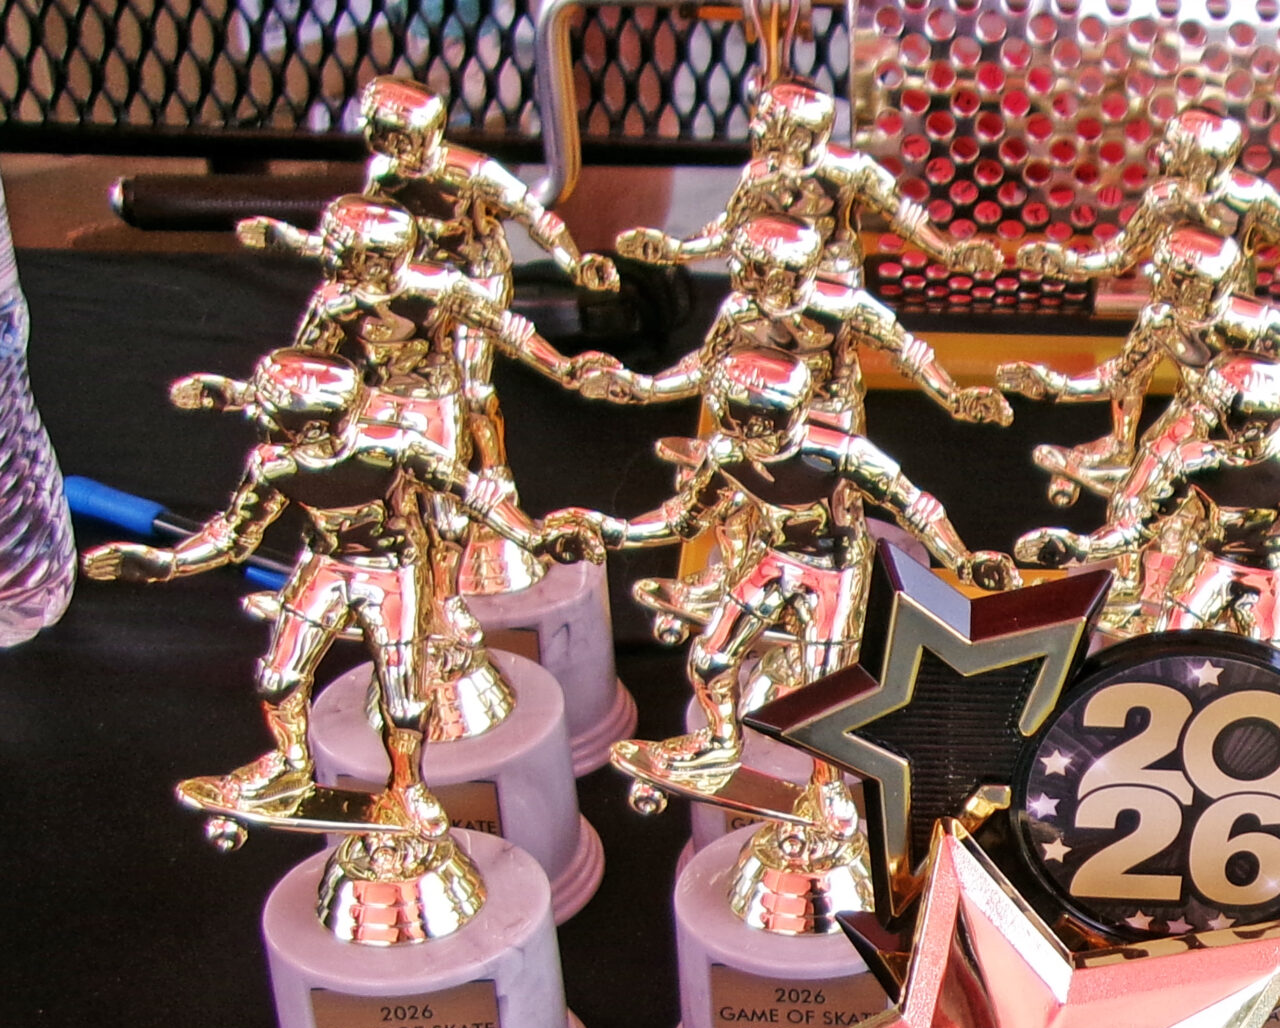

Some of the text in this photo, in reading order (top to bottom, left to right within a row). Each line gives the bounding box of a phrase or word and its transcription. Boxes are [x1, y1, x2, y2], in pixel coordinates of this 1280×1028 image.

[774, 987, 826, 1004] 2026
[380, 1004, 434, 1022] 2026
[719, 1006, 881, 1025] GAME OF SKAT
